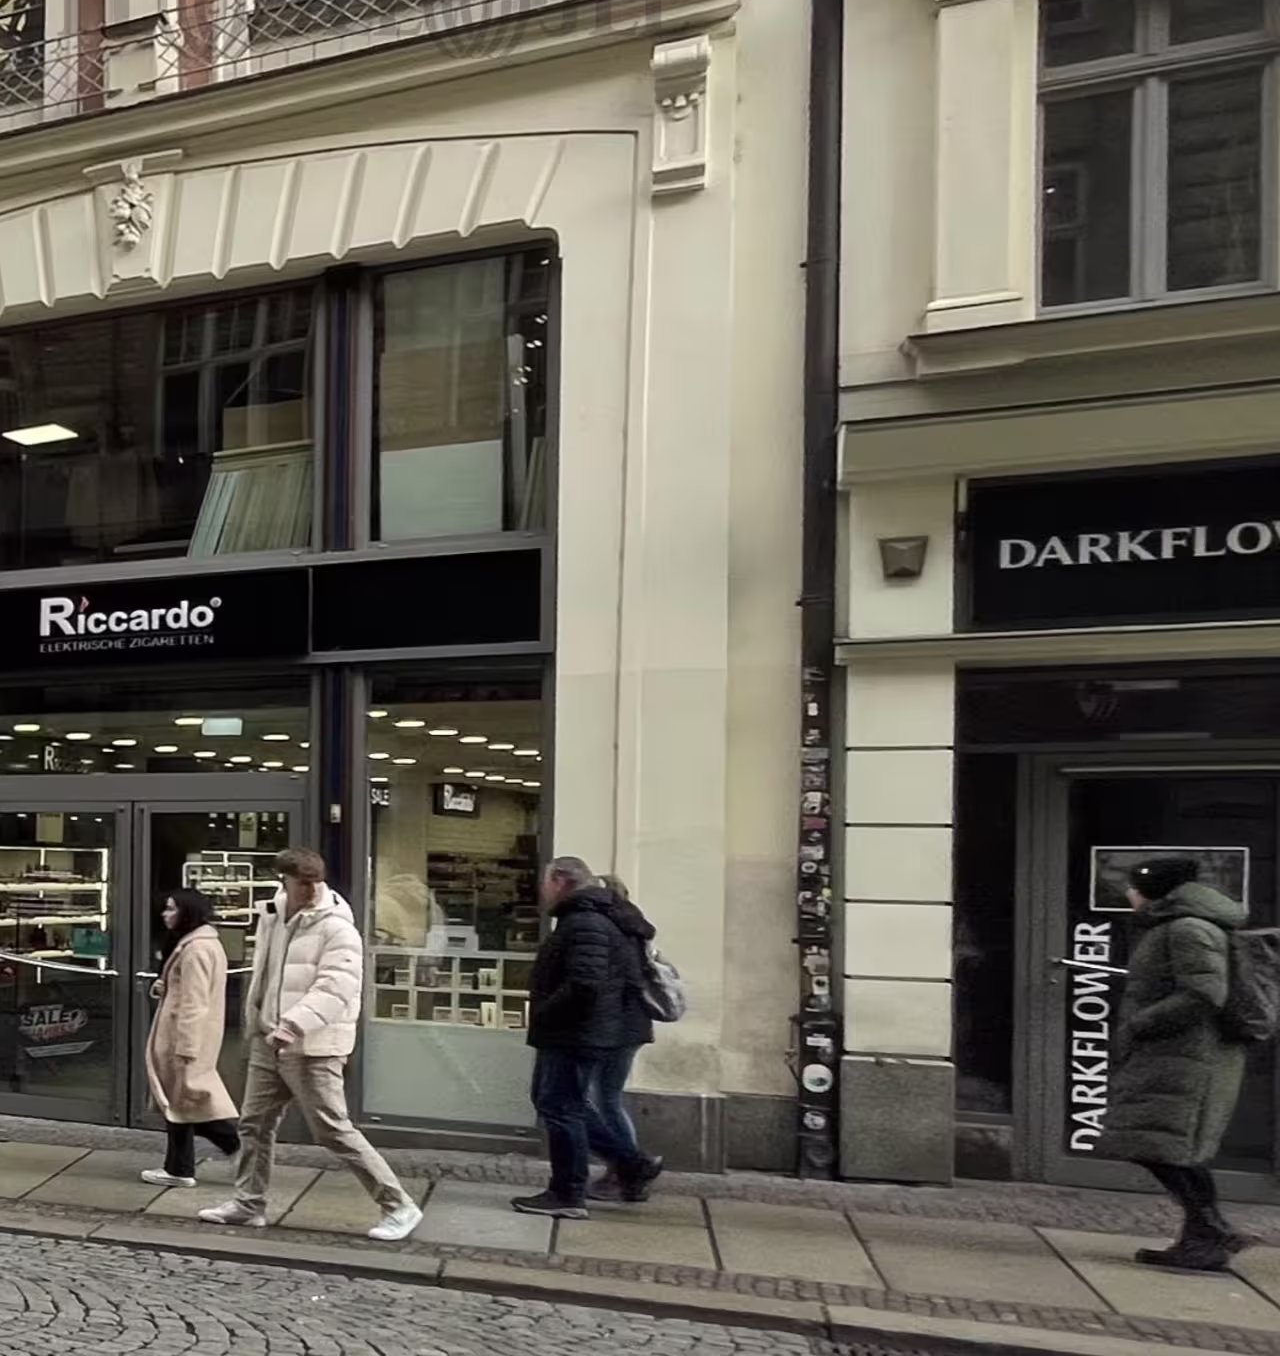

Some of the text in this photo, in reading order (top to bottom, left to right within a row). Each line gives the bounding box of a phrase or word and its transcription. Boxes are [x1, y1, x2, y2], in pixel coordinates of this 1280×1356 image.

[999, 520, 1280, 569] DARKFLO
[40, 597, 215, 636] Riccardo
[40, 634, 215, 653] ELEKTRISCHE ZIGARETTEN
